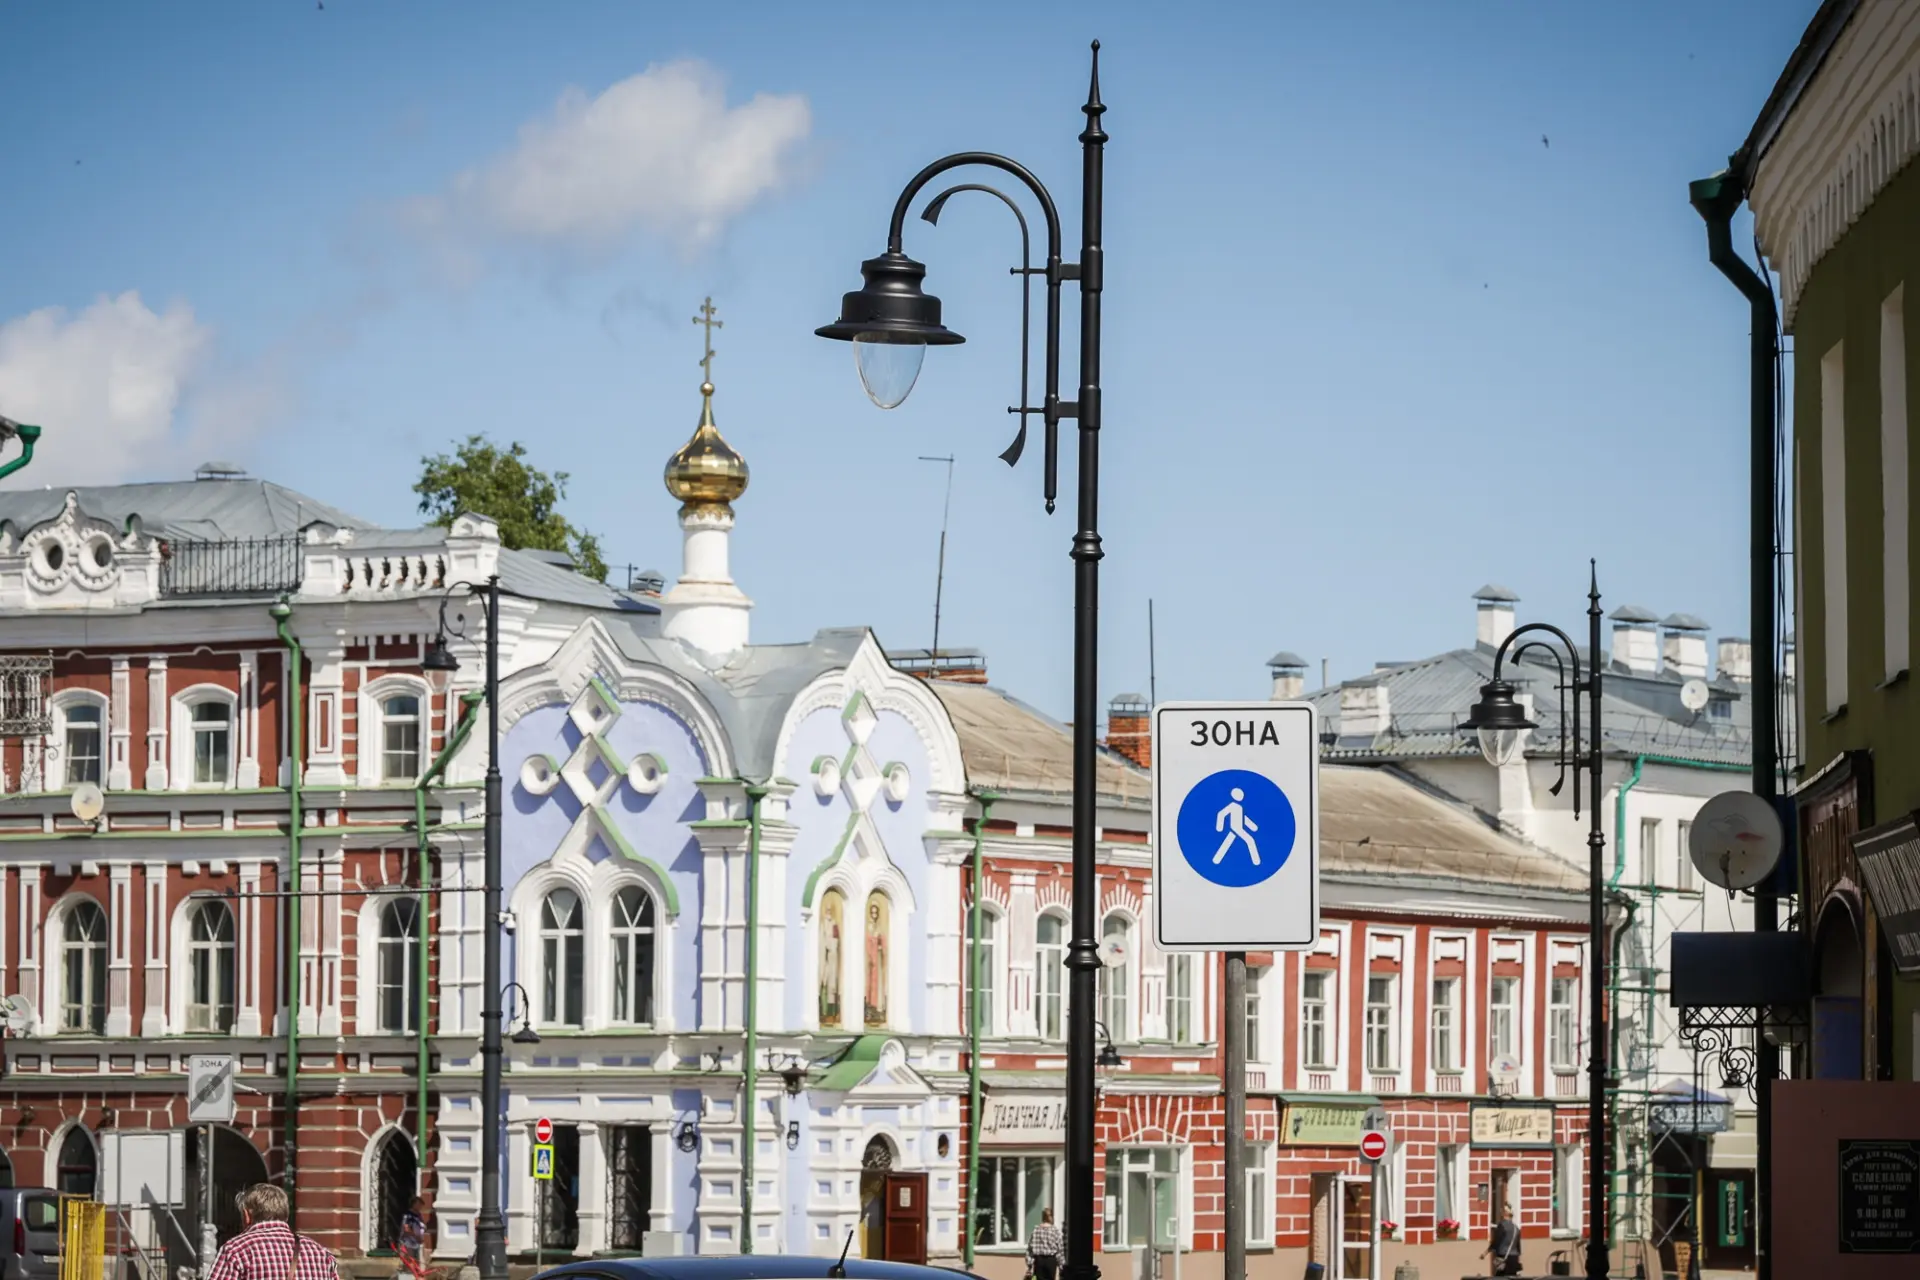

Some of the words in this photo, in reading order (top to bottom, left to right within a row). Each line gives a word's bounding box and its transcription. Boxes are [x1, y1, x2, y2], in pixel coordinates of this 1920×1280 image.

[1190, 720, 1280, 747] ЗОНА
[199, 1059, 223, 1068] ЗОНА
[983, 1104, 1050, 1135] ТАБАЧНАЯ
[1303, 1108, 1358, 1126] СУВЕНИРЫ
[1852, 1172, 1912, 1183] СЕМЕНАМИ
